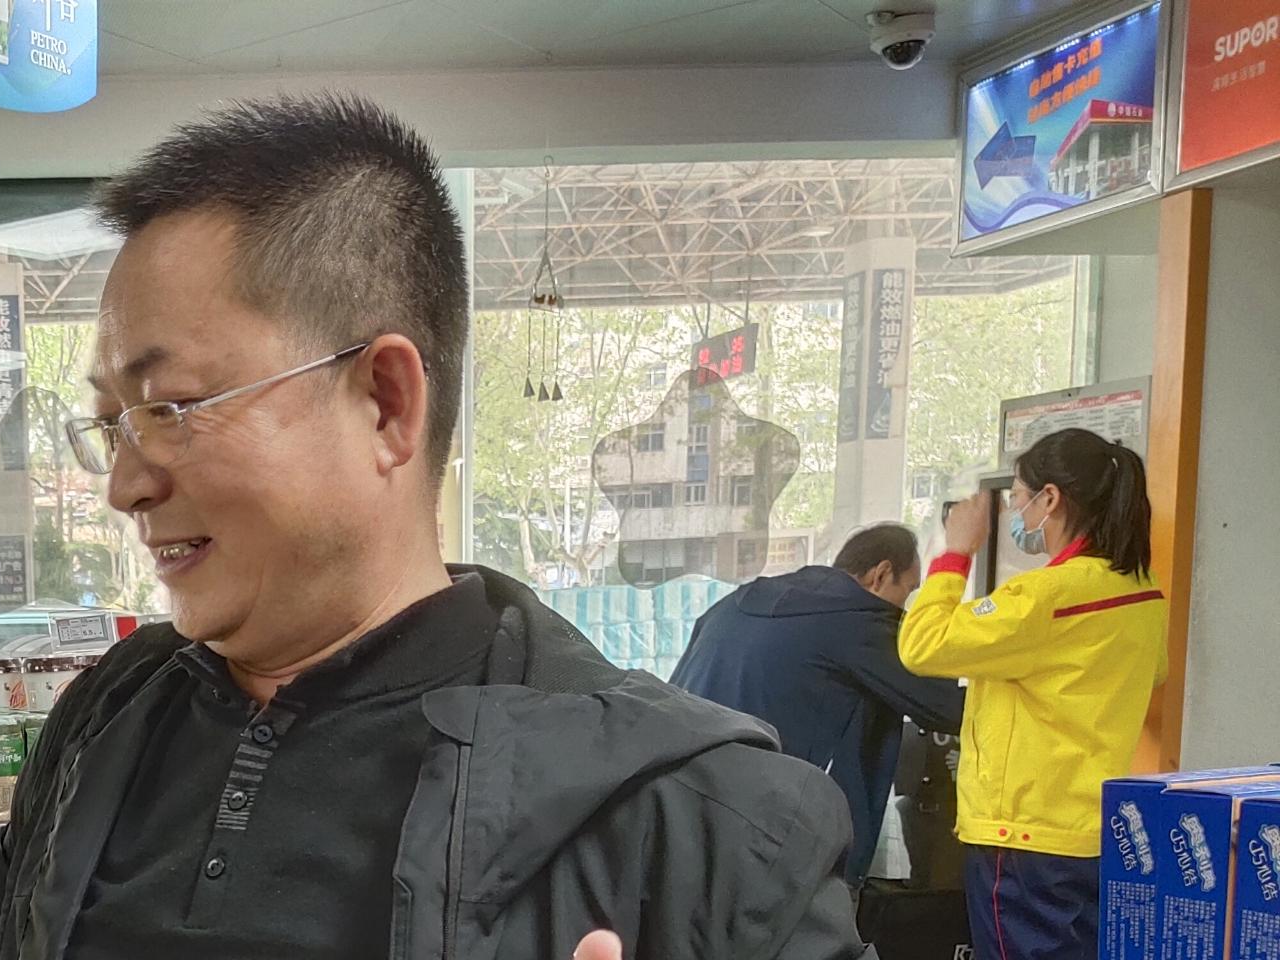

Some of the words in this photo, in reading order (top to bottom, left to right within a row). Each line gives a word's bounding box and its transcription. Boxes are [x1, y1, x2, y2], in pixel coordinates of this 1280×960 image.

[30, 30, 67, 55] PETRO
[30, 49, 67, 74] CHINA
[1214, 14, 1279, 62] SUPOR
[1110, 816, 1138, 871] 巧心结
[1170, 828, 1198, 887] 巧心结
